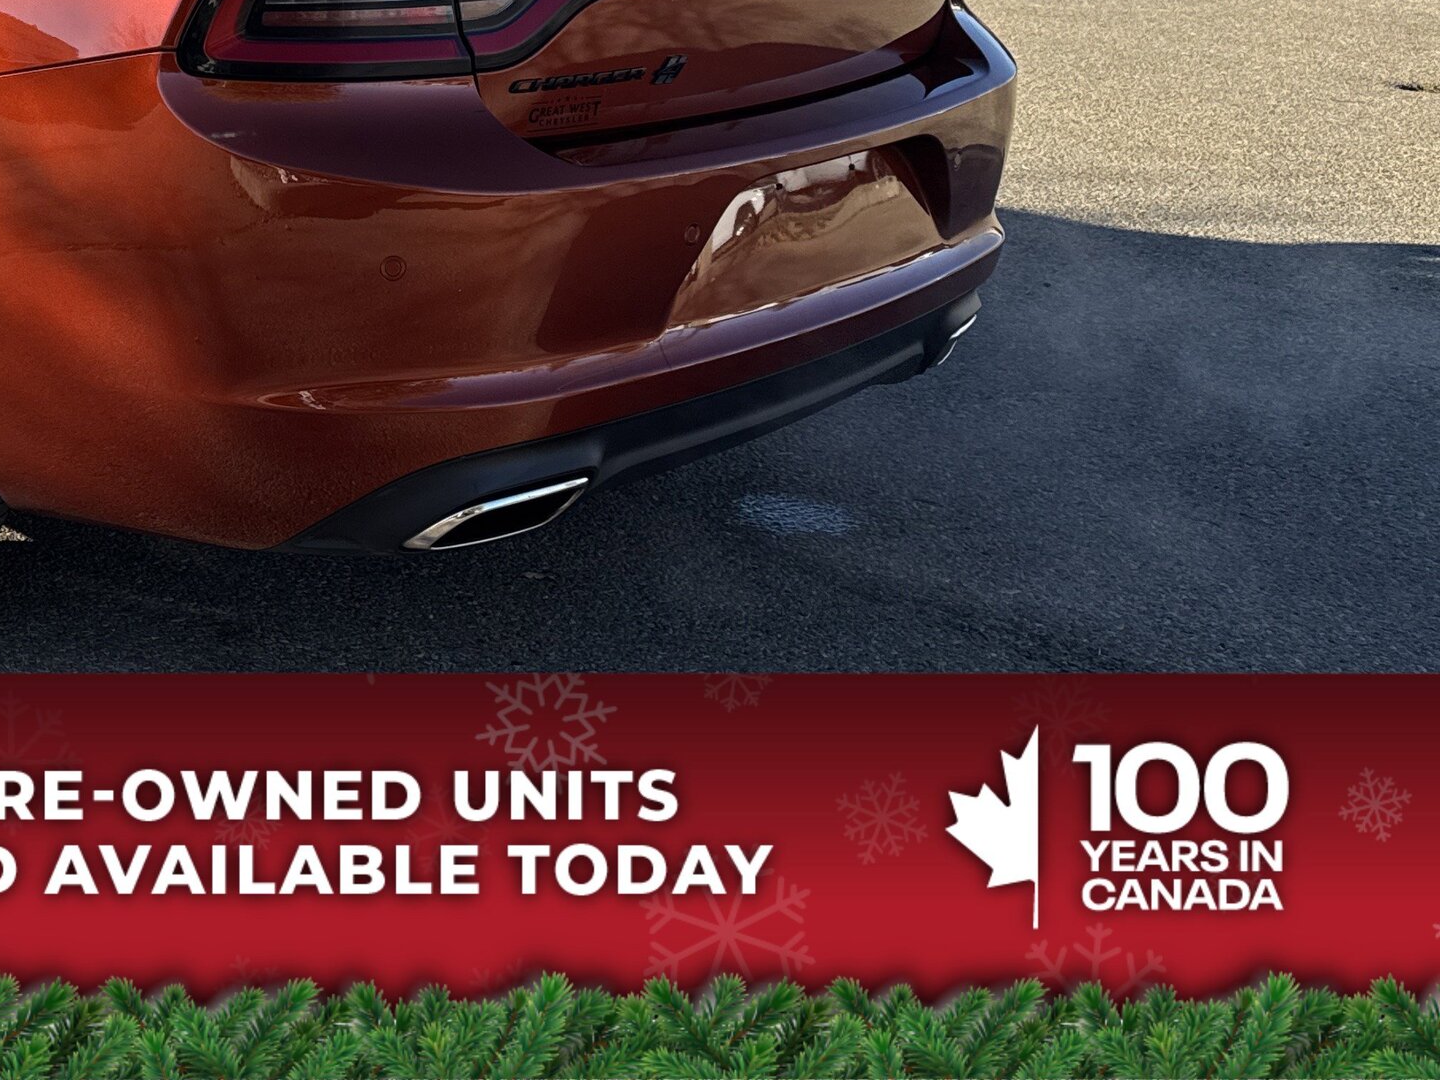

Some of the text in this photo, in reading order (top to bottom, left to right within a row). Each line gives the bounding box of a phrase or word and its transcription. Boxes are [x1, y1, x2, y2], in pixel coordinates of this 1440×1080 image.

[508, 66, 647, 94] CHARGER
[528, 100, 602, 124] GREAT WEST
[539, 113, 590, 127] CHRYSLER
